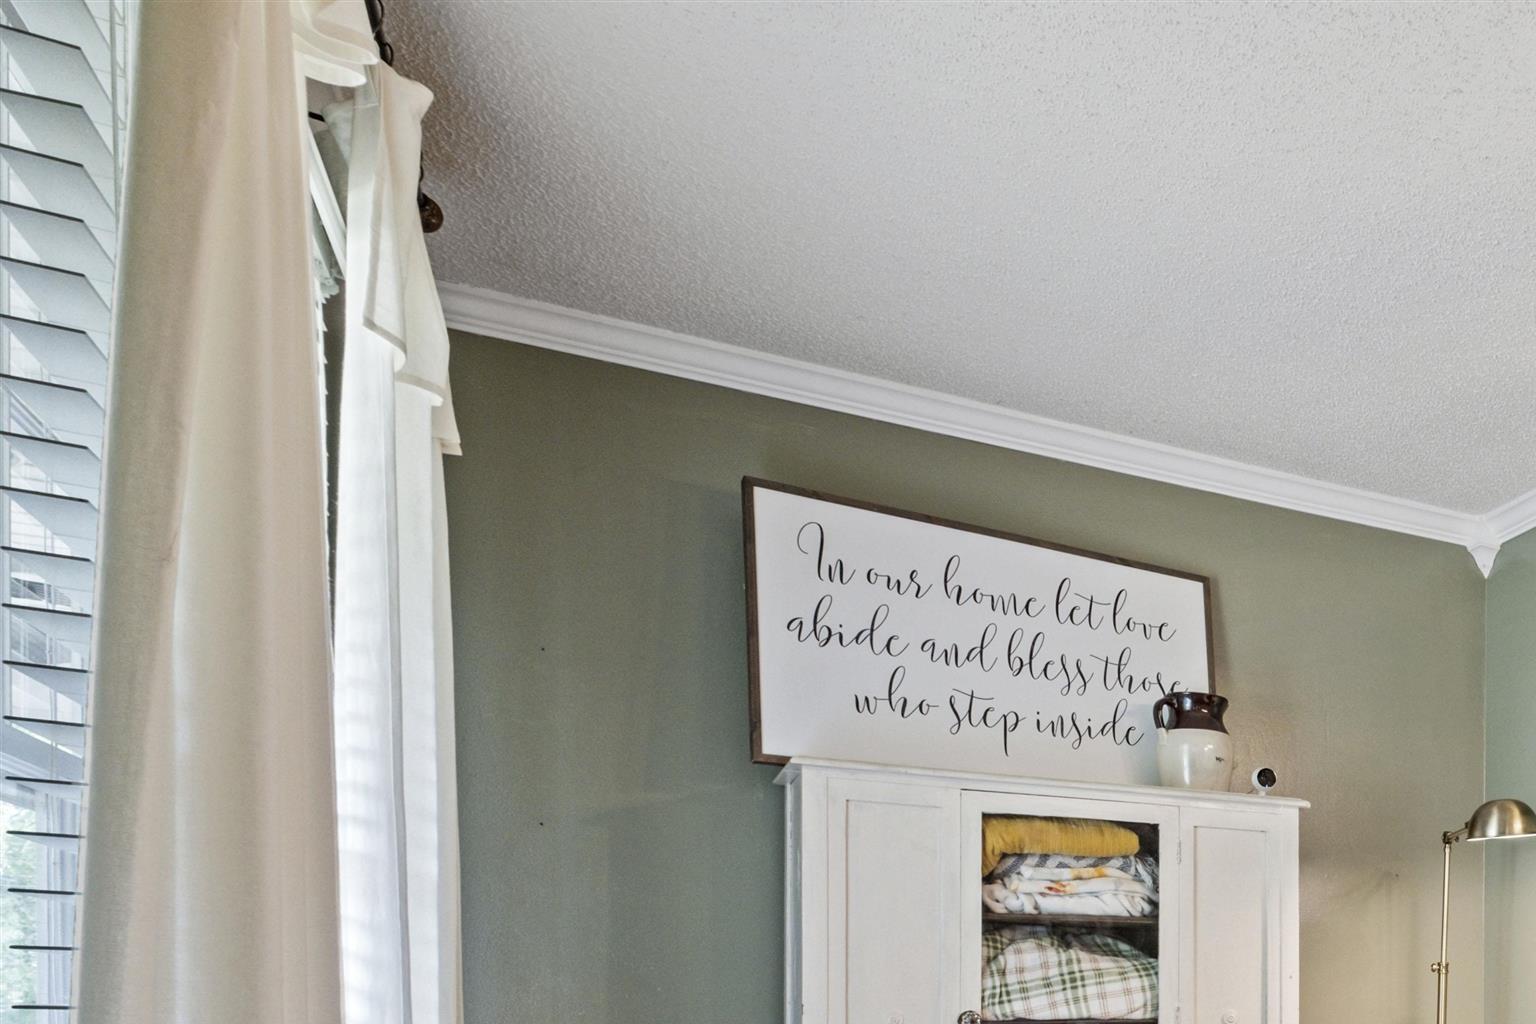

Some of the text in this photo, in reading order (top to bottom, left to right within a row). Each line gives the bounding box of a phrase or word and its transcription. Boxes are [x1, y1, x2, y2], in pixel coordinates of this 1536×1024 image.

[797, 521, 1177, 642] In our home let love
[786, 594, 910, 657] abide
[920, 623, 998, 672] and
[1007, 628, 1094, 696] bless
[854, 666, 1145, 757] who step inside
